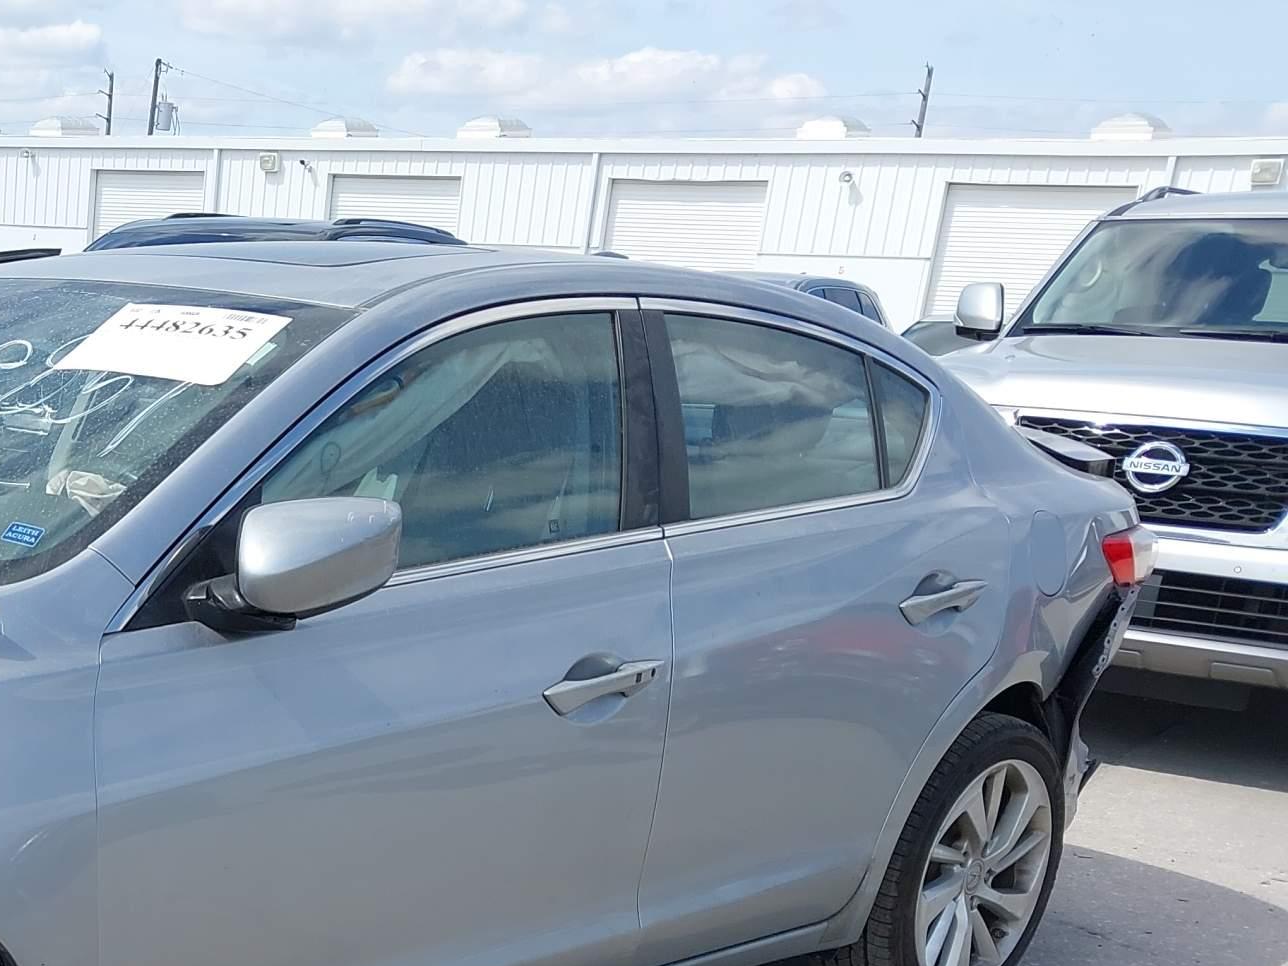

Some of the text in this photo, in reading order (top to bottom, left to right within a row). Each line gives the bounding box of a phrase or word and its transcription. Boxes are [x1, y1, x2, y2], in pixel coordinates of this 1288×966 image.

[120, 317, 254, 340] 44482635
[1129, 460, 1182, 473] NISSAN
[5, 531, 36, 543] ACURA
[12, 525, 40, 537] LEITH
